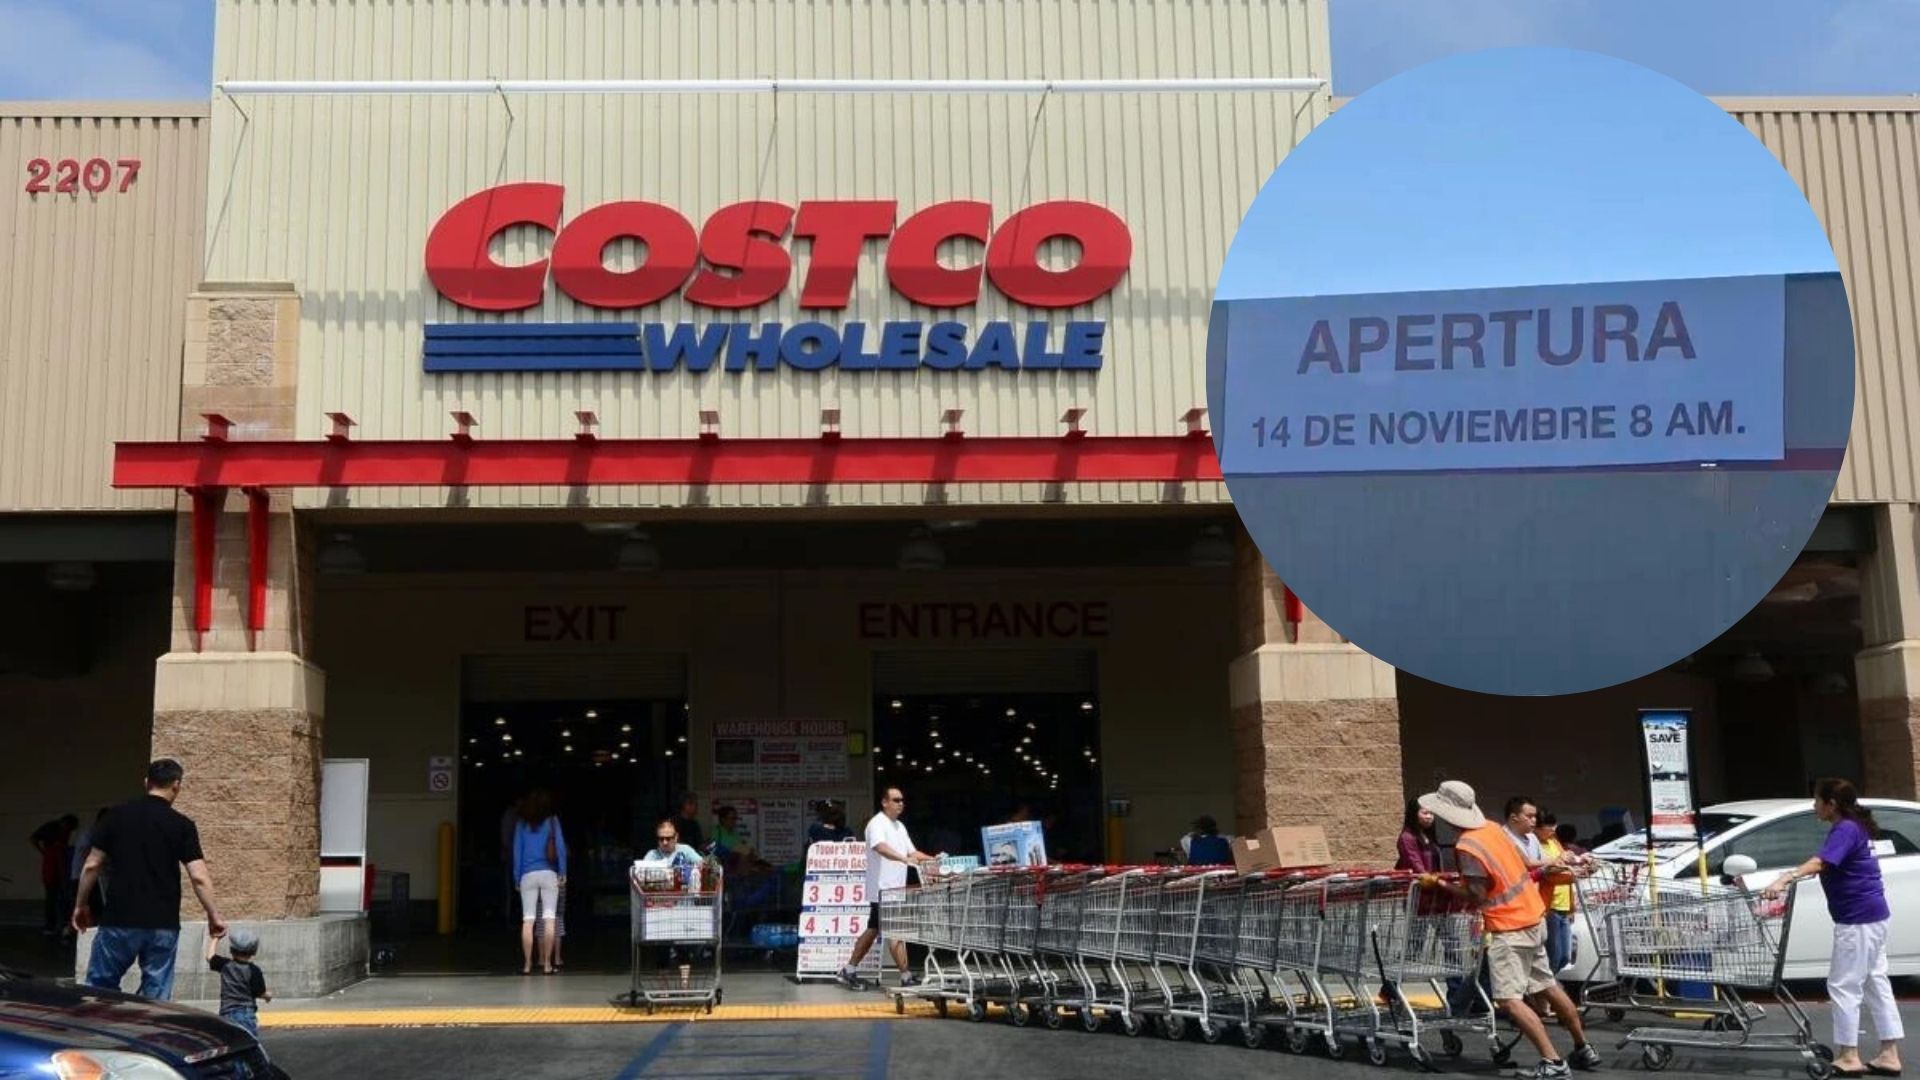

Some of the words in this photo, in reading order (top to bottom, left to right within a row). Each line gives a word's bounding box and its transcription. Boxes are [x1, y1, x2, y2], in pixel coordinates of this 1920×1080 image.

[26, 158, 142, 193] 2207
[425, 182, 1133, 311] COSTCO
[644, 320, 1106, 371] WHOLESALE
[1297, 301, 1697, 375] APERTURA
[1251, 415, 1292, 449] 14
[1304, 413, 1356, 447] DE
[1369, 404, 1617, 446] NOVIEMBRE
[1629, 403, 1655, 438] 8
[1665, 399, 1748, 436] AM.
[523, 605, 627, 642] EXIT
[858, 601, 1110, 639] ENTRANCE
[716, 720, 797, 736] WAREHOUSE
[800, 720, 845, 736] HOURS
[1649, 733, 1681, 743] SAVE
[808, 858, 831, 869] PRICE
[833, 857, 849, 869] FOR
